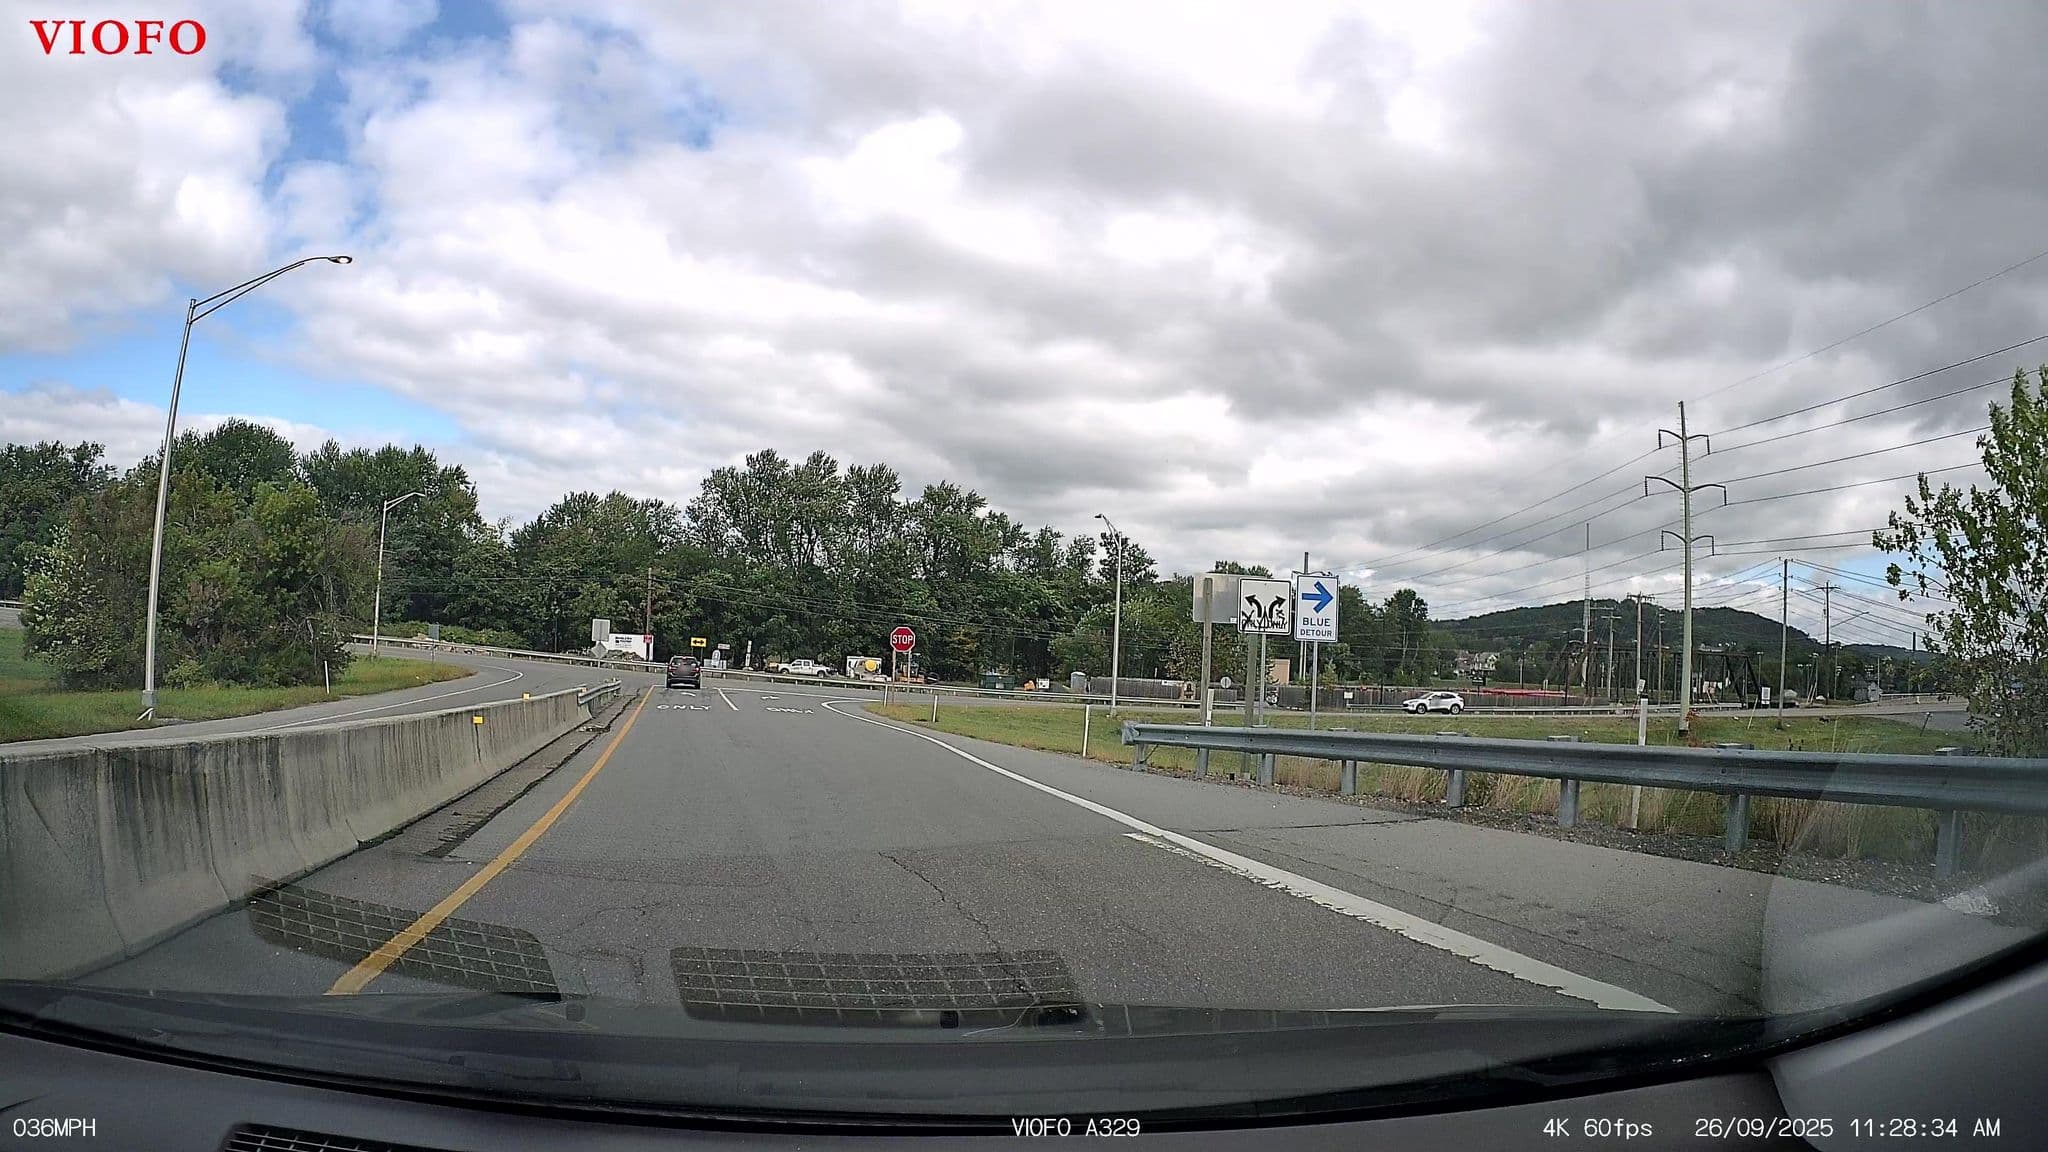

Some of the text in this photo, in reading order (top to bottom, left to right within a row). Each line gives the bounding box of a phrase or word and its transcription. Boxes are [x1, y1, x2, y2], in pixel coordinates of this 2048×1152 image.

[1303, 617, 1330, 627] BLUE
[1300, 629, 1332, 637] DETOUR
[892, 635, 914, 645] STOP
